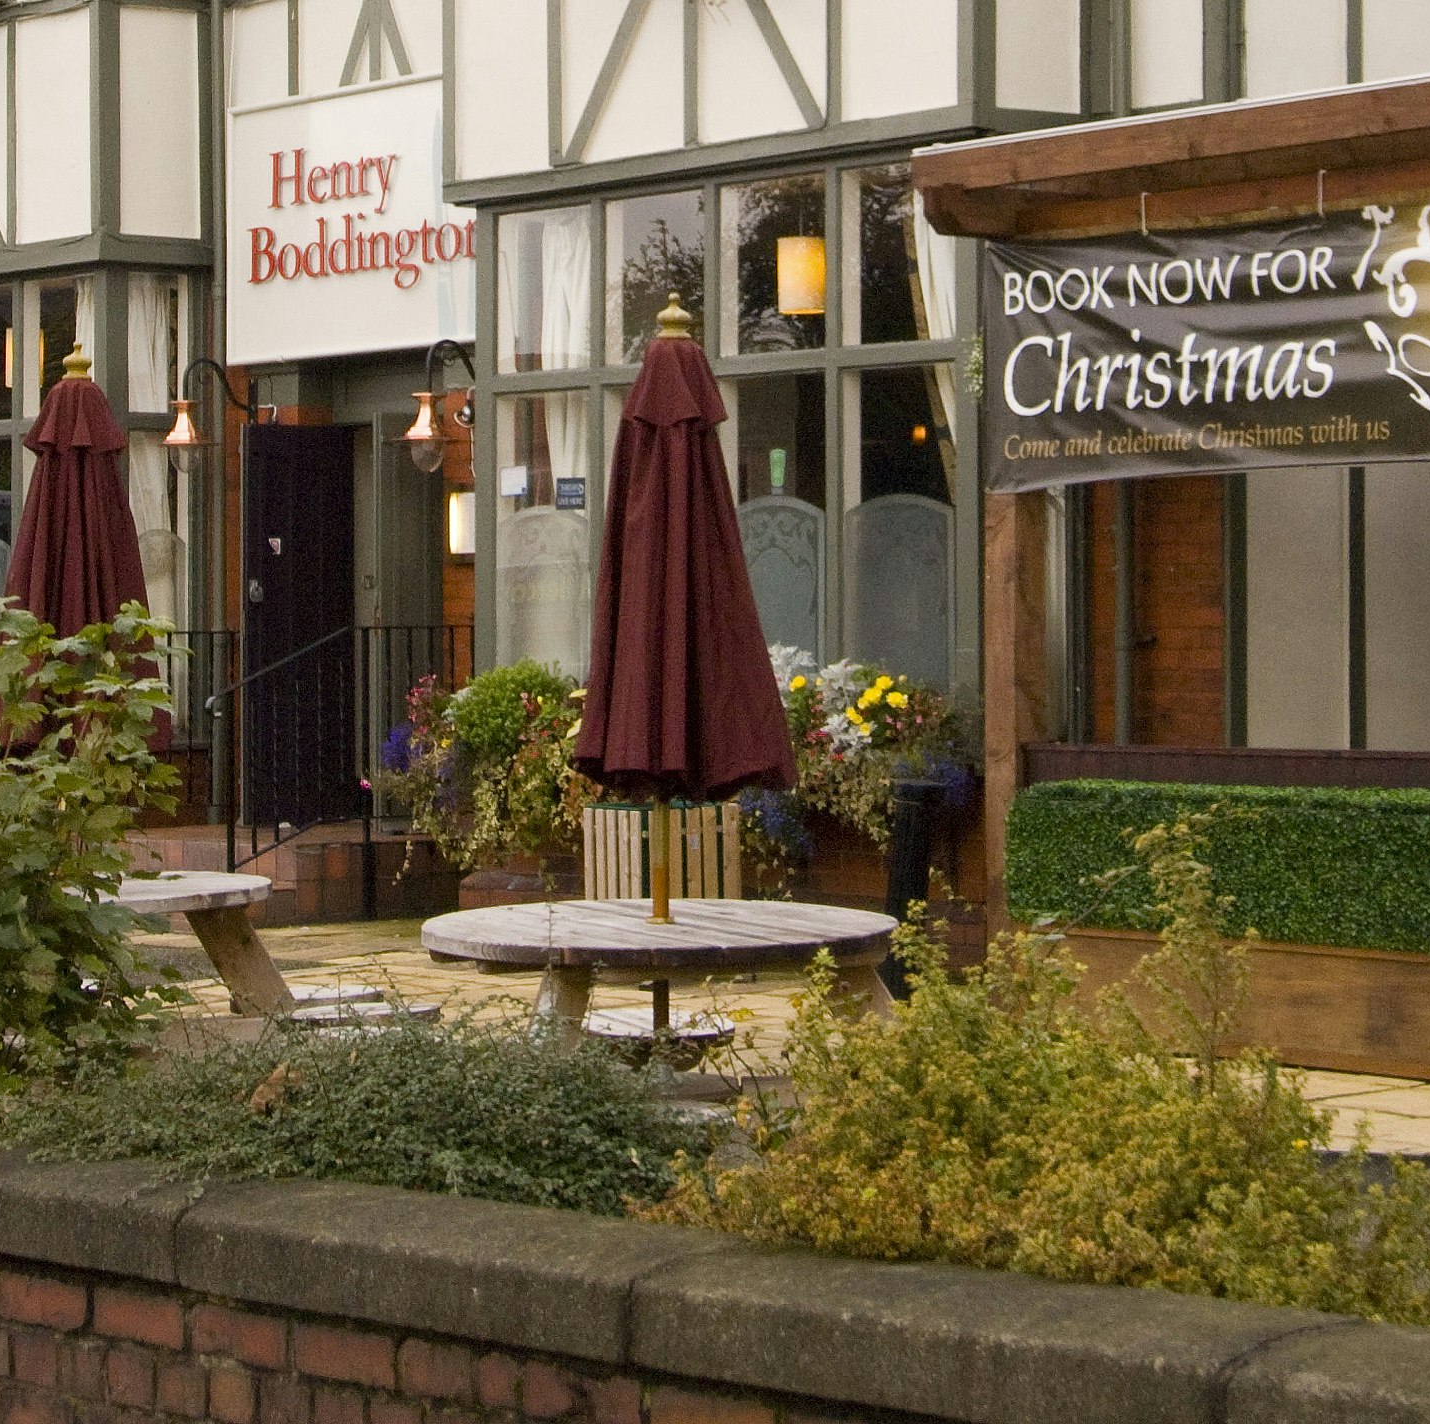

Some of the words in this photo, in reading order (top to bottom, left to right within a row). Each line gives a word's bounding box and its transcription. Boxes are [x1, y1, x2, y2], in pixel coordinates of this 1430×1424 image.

[267, 147, 397, 215] Henry
[1003, 265, 1115, 317] BOOK
[1127, 255, 1238, 308] NOW
[1249, 246, 1337, 296] FOR
[1003, 329, 1337, 418] Christmas
[1003, 432, 1061, 461] Come
[1065, 428, 1103, 457] and
[1107, 423, 1193, 456] celebrate
[1197, 420, 1305, 452] Christmas
[1309, 415, 1359, 446] with
[1364, 421, 1392, 443] us
